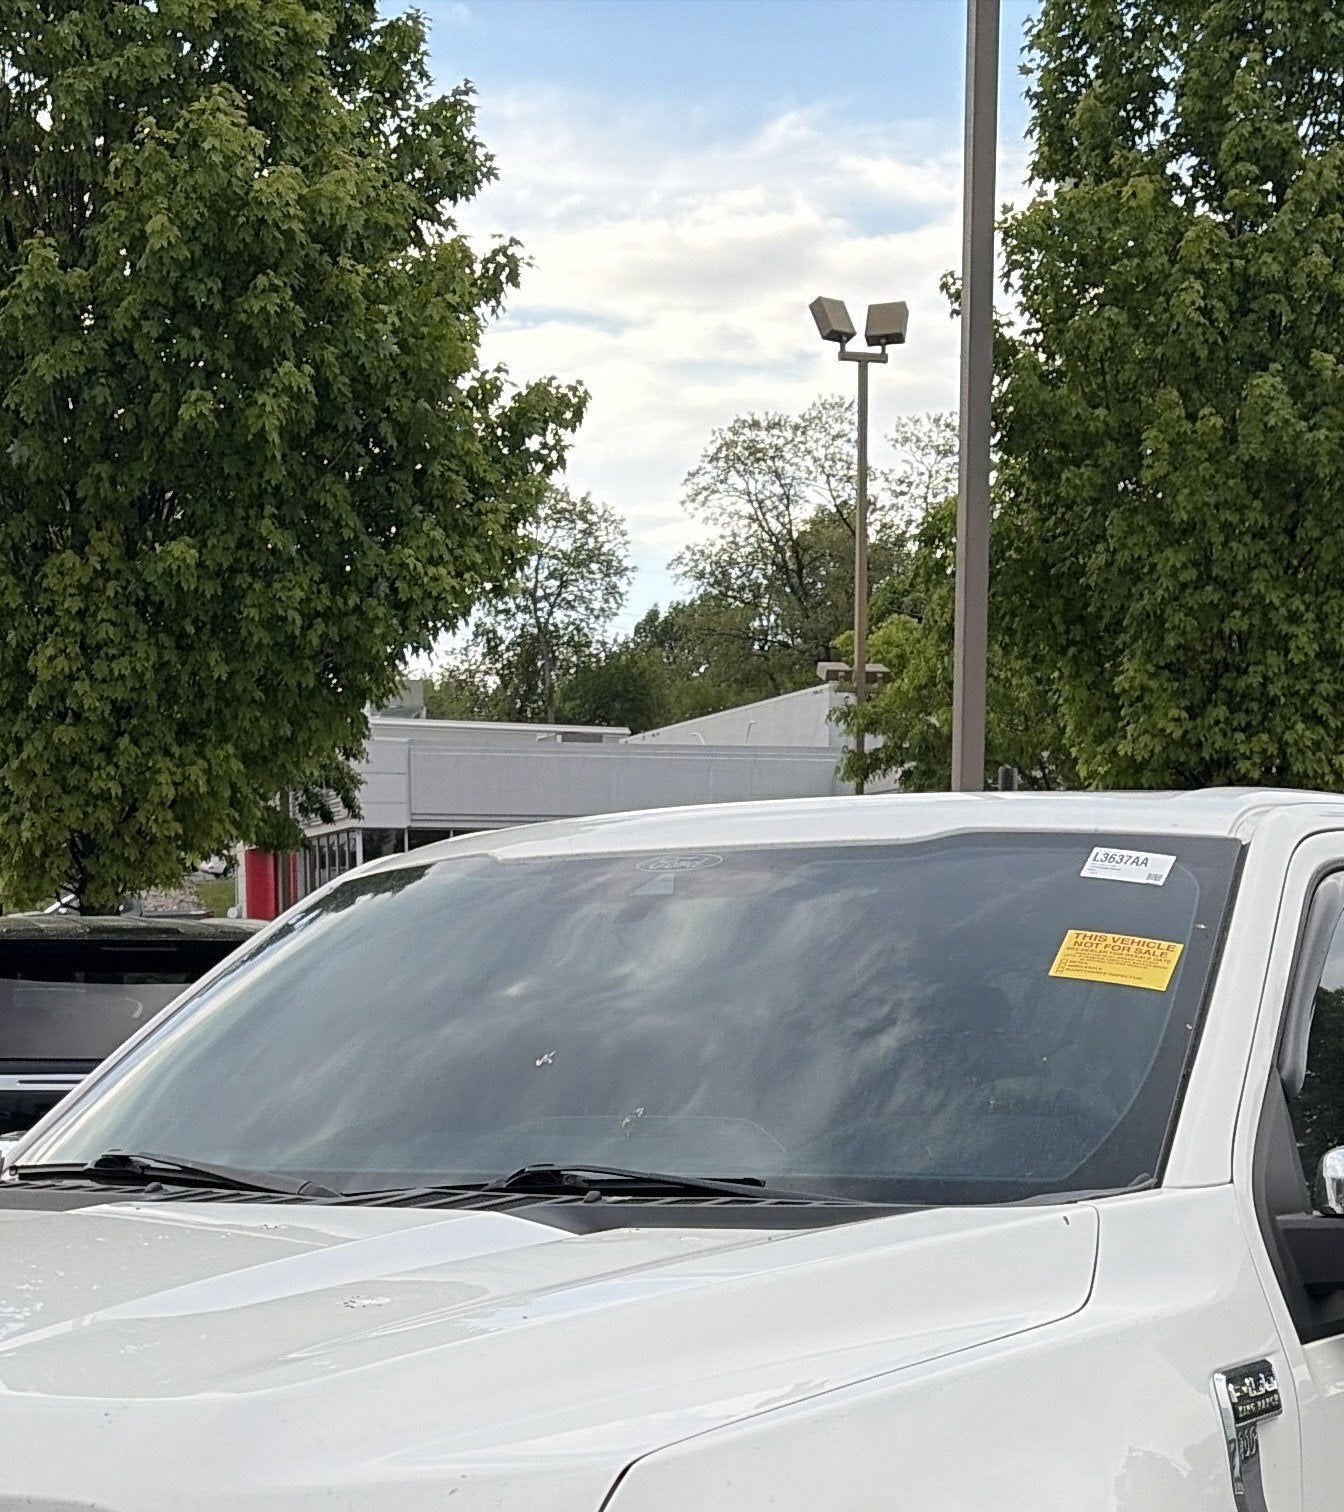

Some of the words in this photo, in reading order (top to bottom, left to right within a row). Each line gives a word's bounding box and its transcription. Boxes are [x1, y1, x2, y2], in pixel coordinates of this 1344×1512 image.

[1092, 851, 1149, 867] L3637AA
[1073, 940, 1100, 951] NOT
[1103, 943, 1131, 953] FOR
[1134, 947, 1169, 959] SALE
[1074, 932, 1108, 943] THIS
[1111, 936, 1177, 953] VEHICLE
